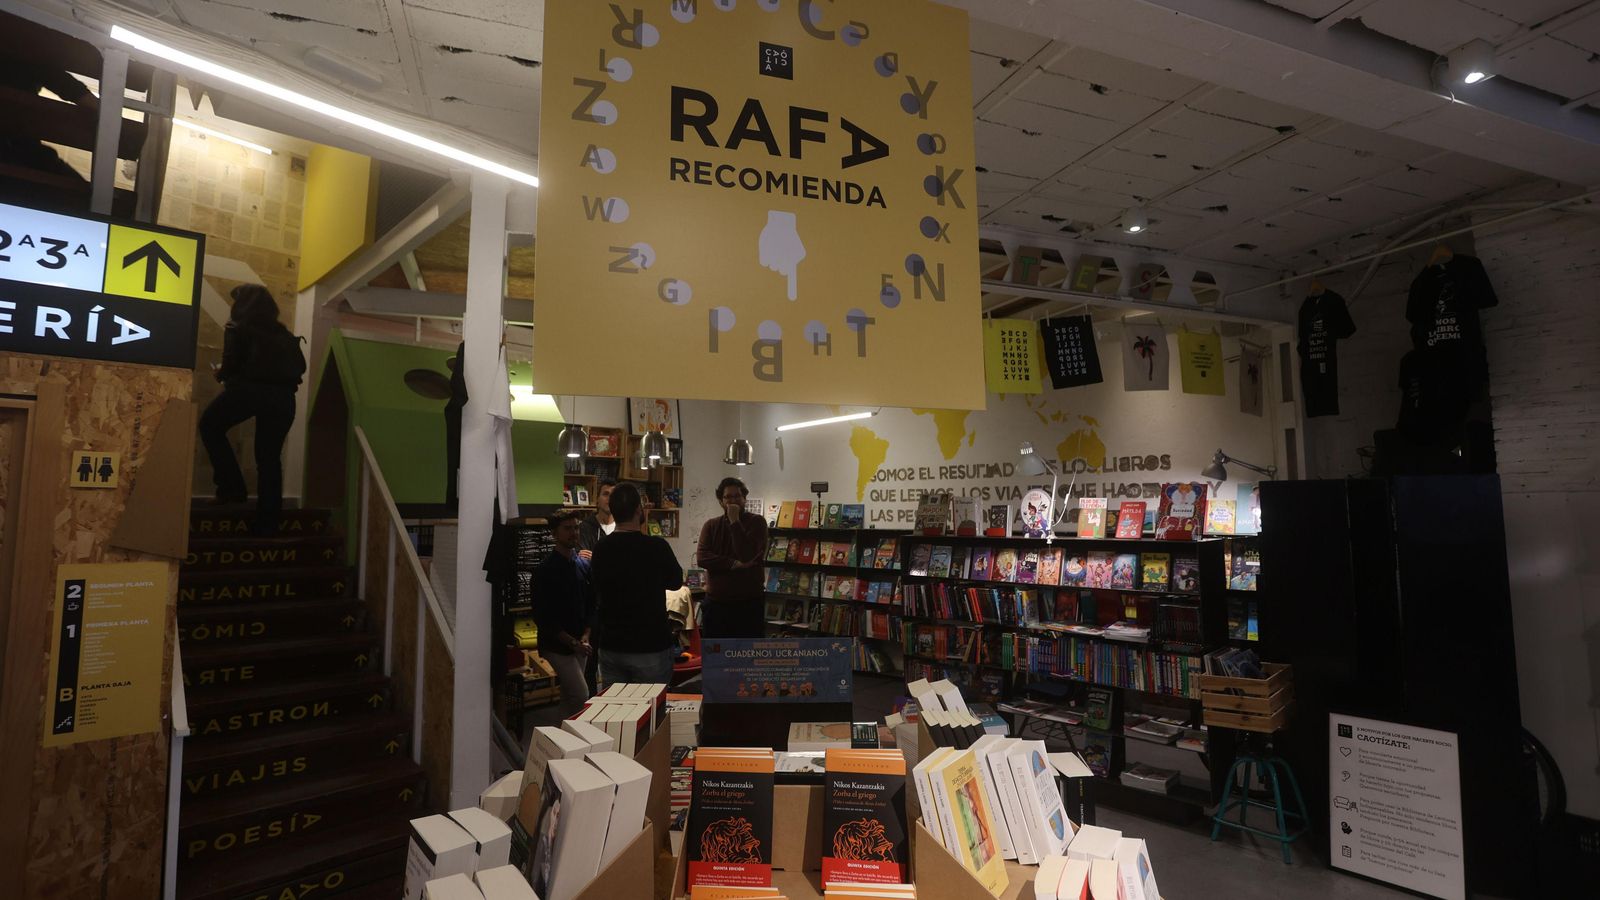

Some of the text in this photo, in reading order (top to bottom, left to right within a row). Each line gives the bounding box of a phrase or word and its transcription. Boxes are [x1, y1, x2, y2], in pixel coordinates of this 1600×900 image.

[571, 77, 607, 125] Z
[905, 75, 938, 120] Y
[669, 85, 890, 169] RAFA
[580, 144, 604, 169] A
[669, 157, 887, 209] RECOMIENDA
[935, 165, 966, 209] K
[582, 195, 617, 223] W
[657, 278, 679, 303] G
[912, 261, 947, 302] N
[812, 332, 832, 356] H
[846, 315, 875, 358] T
[751, 338, 783, 382] B
[870, 468, 915, 482] SOMOS
[919, 467, 935, 480] EL
[939, 462, 1015, 480] RESULTAD
[1103, 454, 1171, 473] LIBROS
[870, 490, 896, 502] QUE
[870, 510, 894, 522] LAS
[66, 584, 82, 599] 2
[66, 624, 77, 639] 1
[724, 649, 829, 658] CUADERNOS UCRANIANOS
[59, 688, 74, 703] B
[186, 757, 308, 794] VIAJES
[851, 781, 885, 790] Kazantzakis
[187, 812, 322, 859] POESÍA
